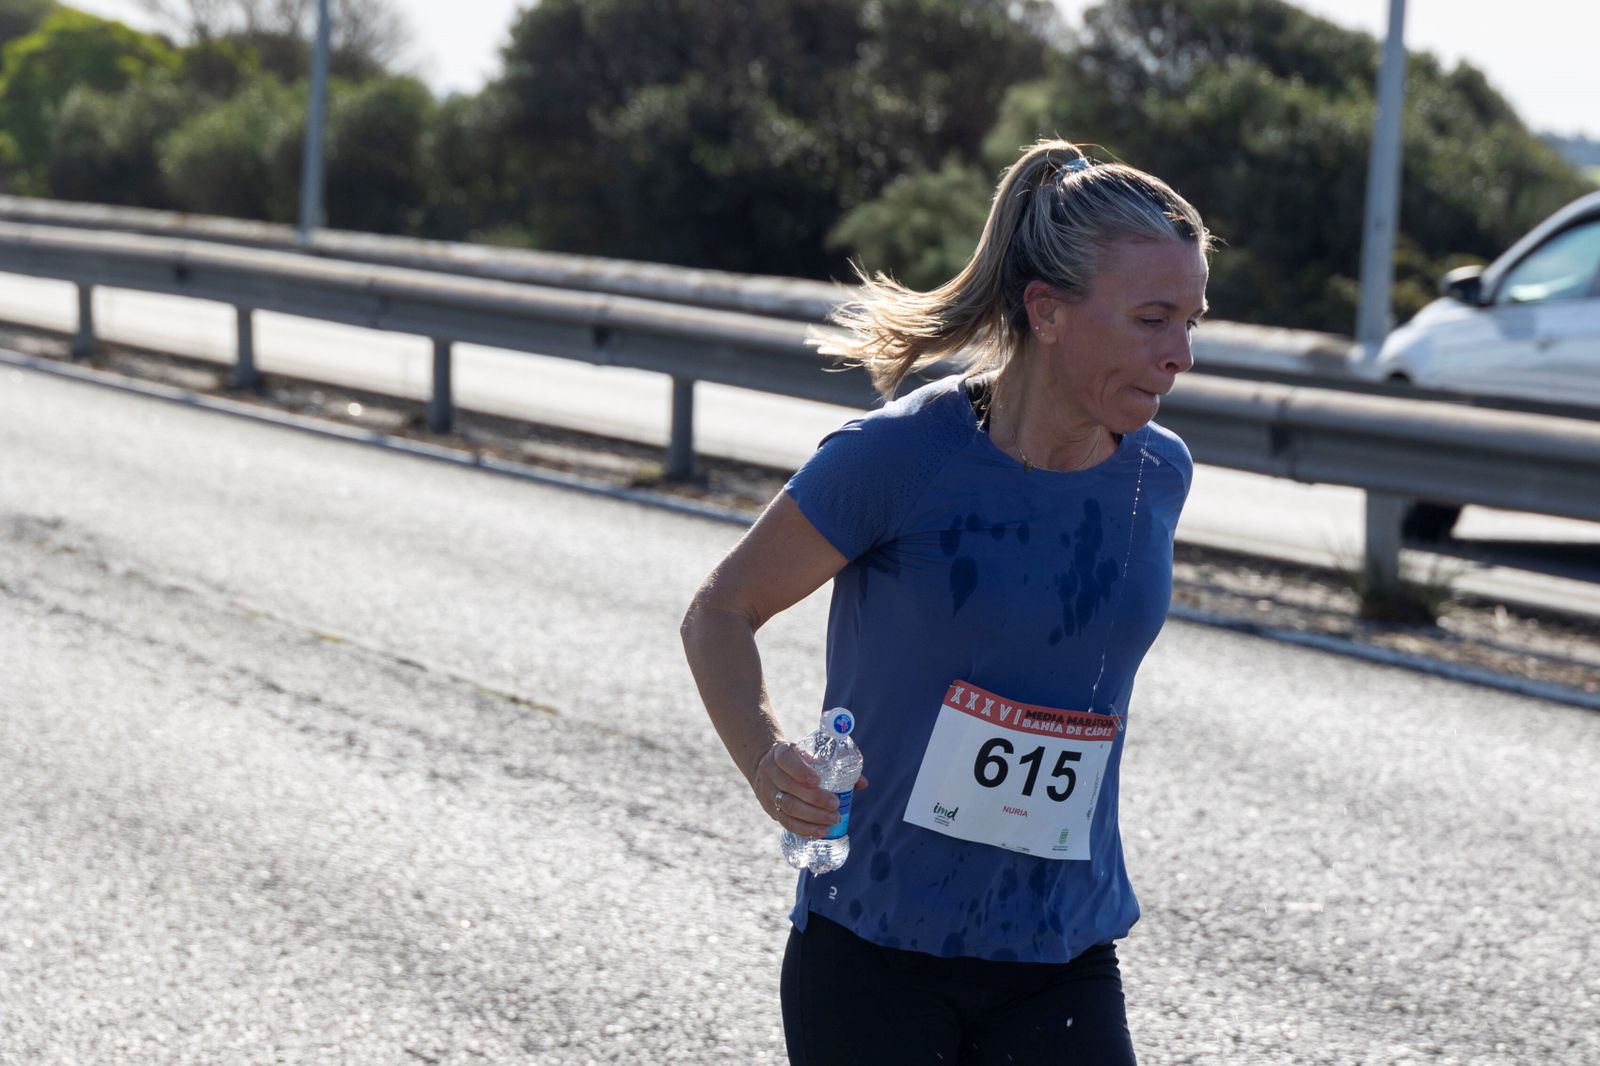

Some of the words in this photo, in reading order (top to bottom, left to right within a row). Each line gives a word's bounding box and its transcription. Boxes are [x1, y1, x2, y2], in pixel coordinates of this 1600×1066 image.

[950, 685, 1022, 726] XXXVI
[1025, 710, 1064, 724] MEDIA
[1022, 718, 1063, 733] BAHÍA
[1066, 725, 1082, 736] DE
[973, 737, 1082, 803] 615
[933, 802, 959, 822] imd
[1002, 805, 1029, 818] NURIA
